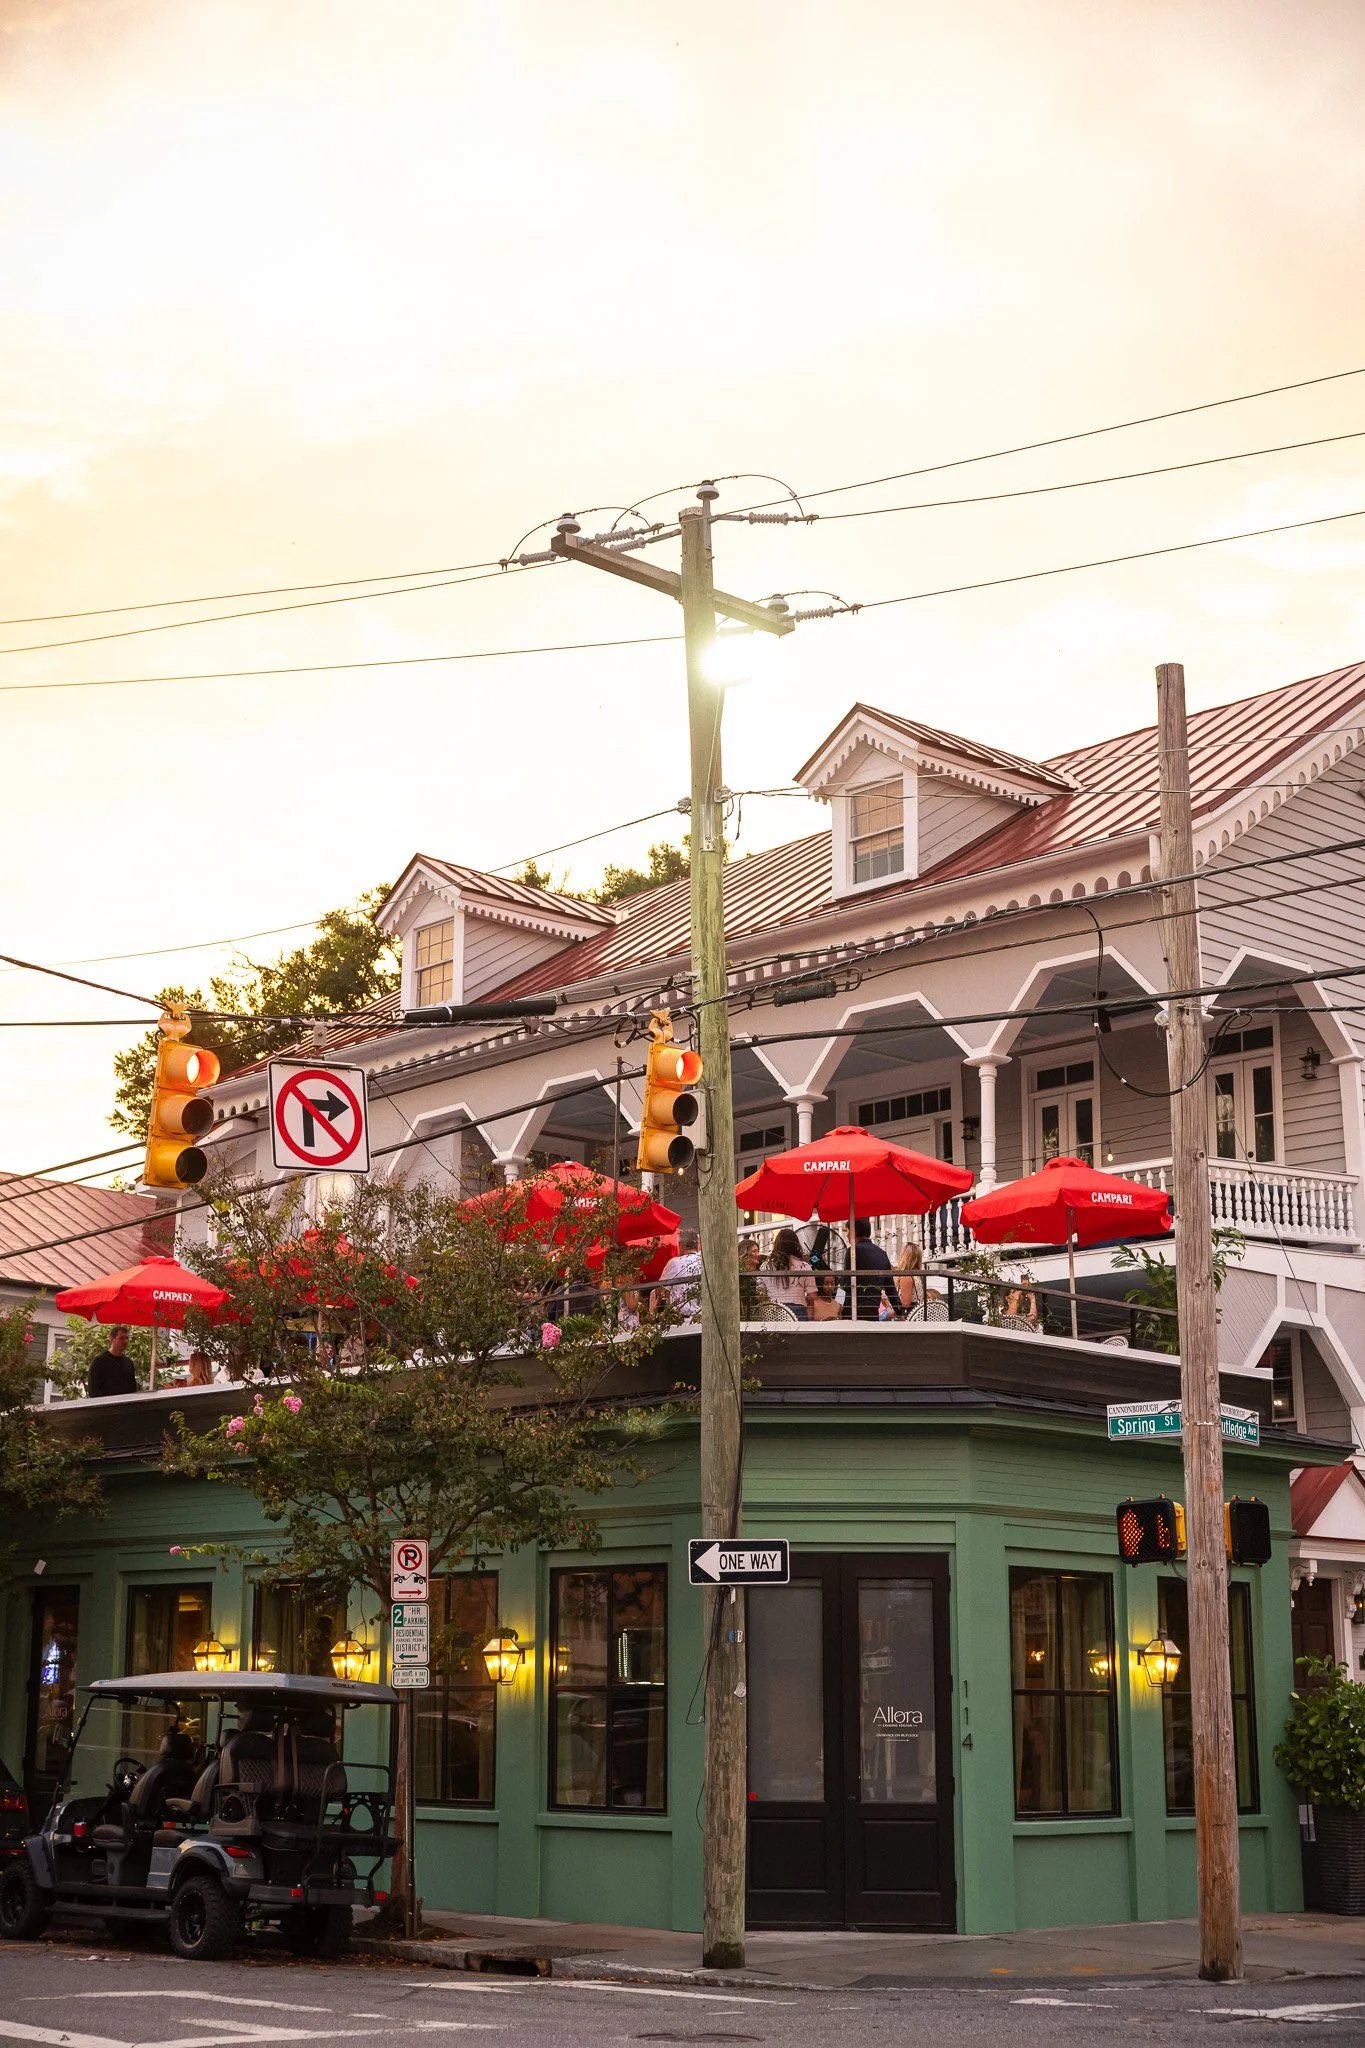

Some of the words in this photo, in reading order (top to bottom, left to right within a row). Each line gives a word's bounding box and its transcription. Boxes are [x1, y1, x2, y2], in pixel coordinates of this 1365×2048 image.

[803, 1160, 850, 1172] CAMPARI
[1091, 1192, 1133, 1205] CAMPARI
[1108, 1403, 1159, 1415] CANNONBOROUGH
[1117, 1417, 1156, 1435] Spring
[1164, 1415, 1174, 1426] St
[1221, 1419, 1247, 1439] utledge
[1247, 1425, 1257, 1437] Ave
[719, 1553, 746, 1570] ONE
[750, 1553, 778, 1570] WAY
[394, 1608, 402, 1624] 2
[411, 1607, 421, 1615] HR
[403, 1616, 427, 1625] PARKING
[395, 1629, 425, 1637] RESIDENTIAL
[395, 1643, 420, 1652] DISTRICT
[422, 1644, 427, 1652] H
[872, 1706, 923, 1724] Allora
